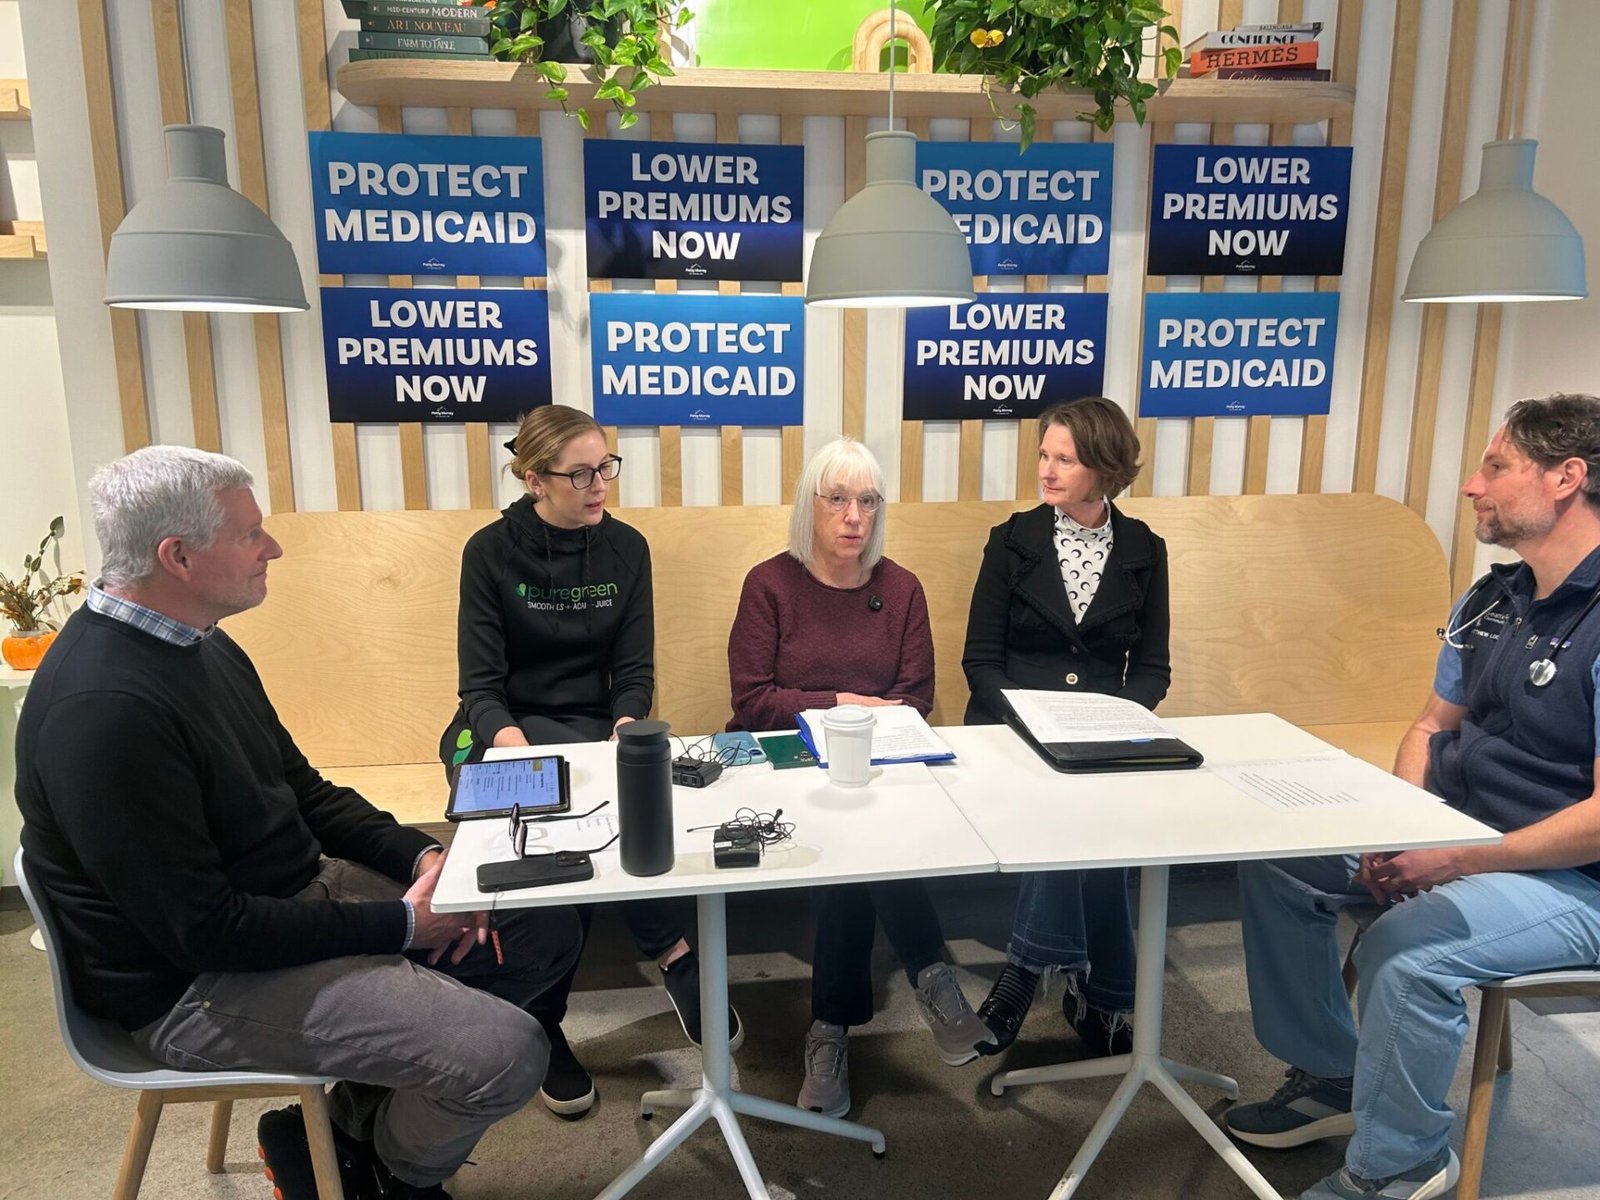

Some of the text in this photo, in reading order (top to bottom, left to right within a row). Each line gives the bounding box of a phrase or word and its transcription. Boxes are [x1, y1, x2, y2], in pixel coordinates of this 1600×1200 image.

[387, 6, 478, 18] MID-CENTURY MODERN
[387, 20, 466, 33] ART NOUVEAU
[1221, 34, 1295, 44] CONFIDENCE
[397, 37, 456, 50] FARM TO TABLE
[329, 162, 528, 198] PROTECT
[632, 153, 759, 184] LOWER
[1196, 157, 1310, 184] LOWER
[922, 169, 1100, 201] PROTECT
[599, 191, 792, 223] PREMIUMS
[1163, 194, 1338, 221] PREMIUMS
[325, 209, 536, 244] MEDICAID
[952, 213, 1103, 244] EDICAID
[652, 231, 741, 260] NOW
[1208, 230, 1289, 256] NOW
[370, 300, 502, 329] LOWER
[949, 303, 1066, 330] LOWER
[607, 321, 791, 354] PROTECT
[1158, 318, 1326, 348] PROTECT
[338, 337, 538, 366] PREMIUMS
[916, 339, 1095, 366] PREMIUMS
[602, 365, 796, 396] MEDICAID
[1150, 359, 1326, 388] MEDICAID
[395, 376, 487, 403] NOW
[963, 375, 1047, 401] NOW
[527, 601, 565, 611] SMOOTHES
[595, 599, 613, 608] JUICE
[528, 583, 618, 602] puregreen
